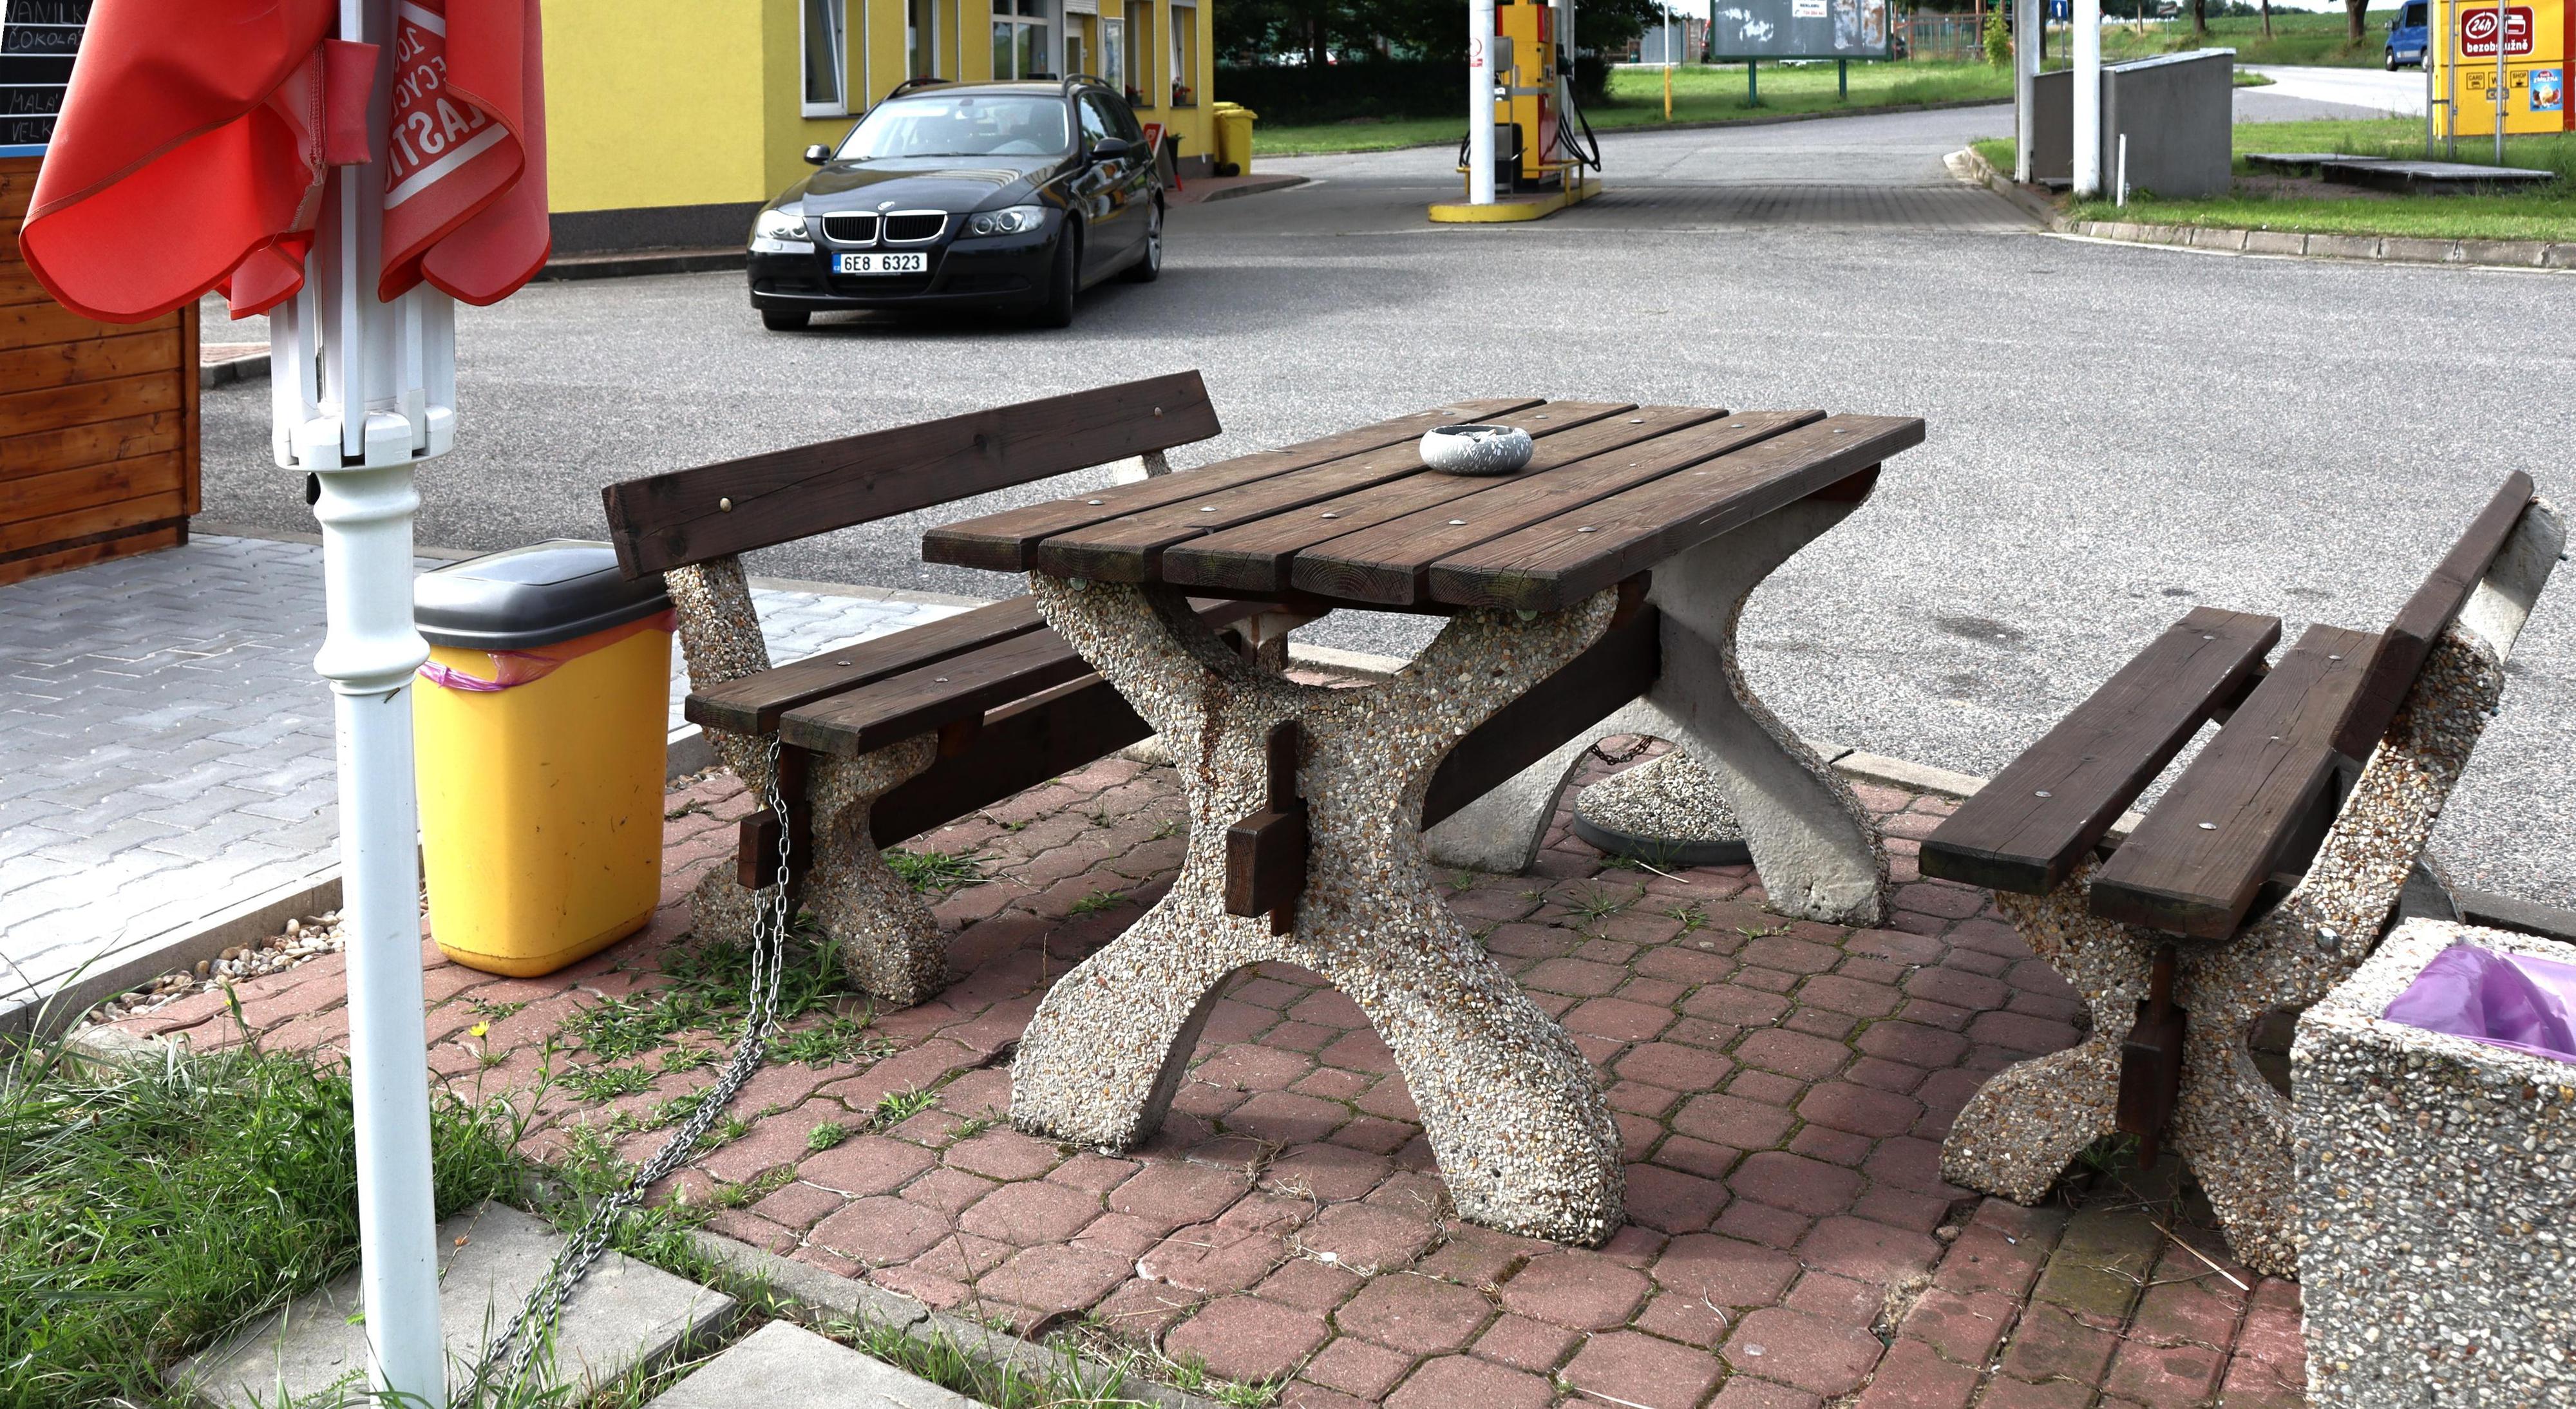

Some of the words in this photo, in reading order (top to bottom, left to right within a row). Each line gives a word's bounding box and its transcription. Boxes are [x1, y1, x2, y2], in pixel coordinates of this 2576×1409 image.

[2471, 19, 2492, 32] 24h
[8, 26, 81, 50] ČOKOLÁ
[2467, 39, 2528, 53] bezobužně
[9, 90, 58, 114] MALÁ
[844, 256, 871, 270] 6E8
[882, 255, 920, 270] 6323
